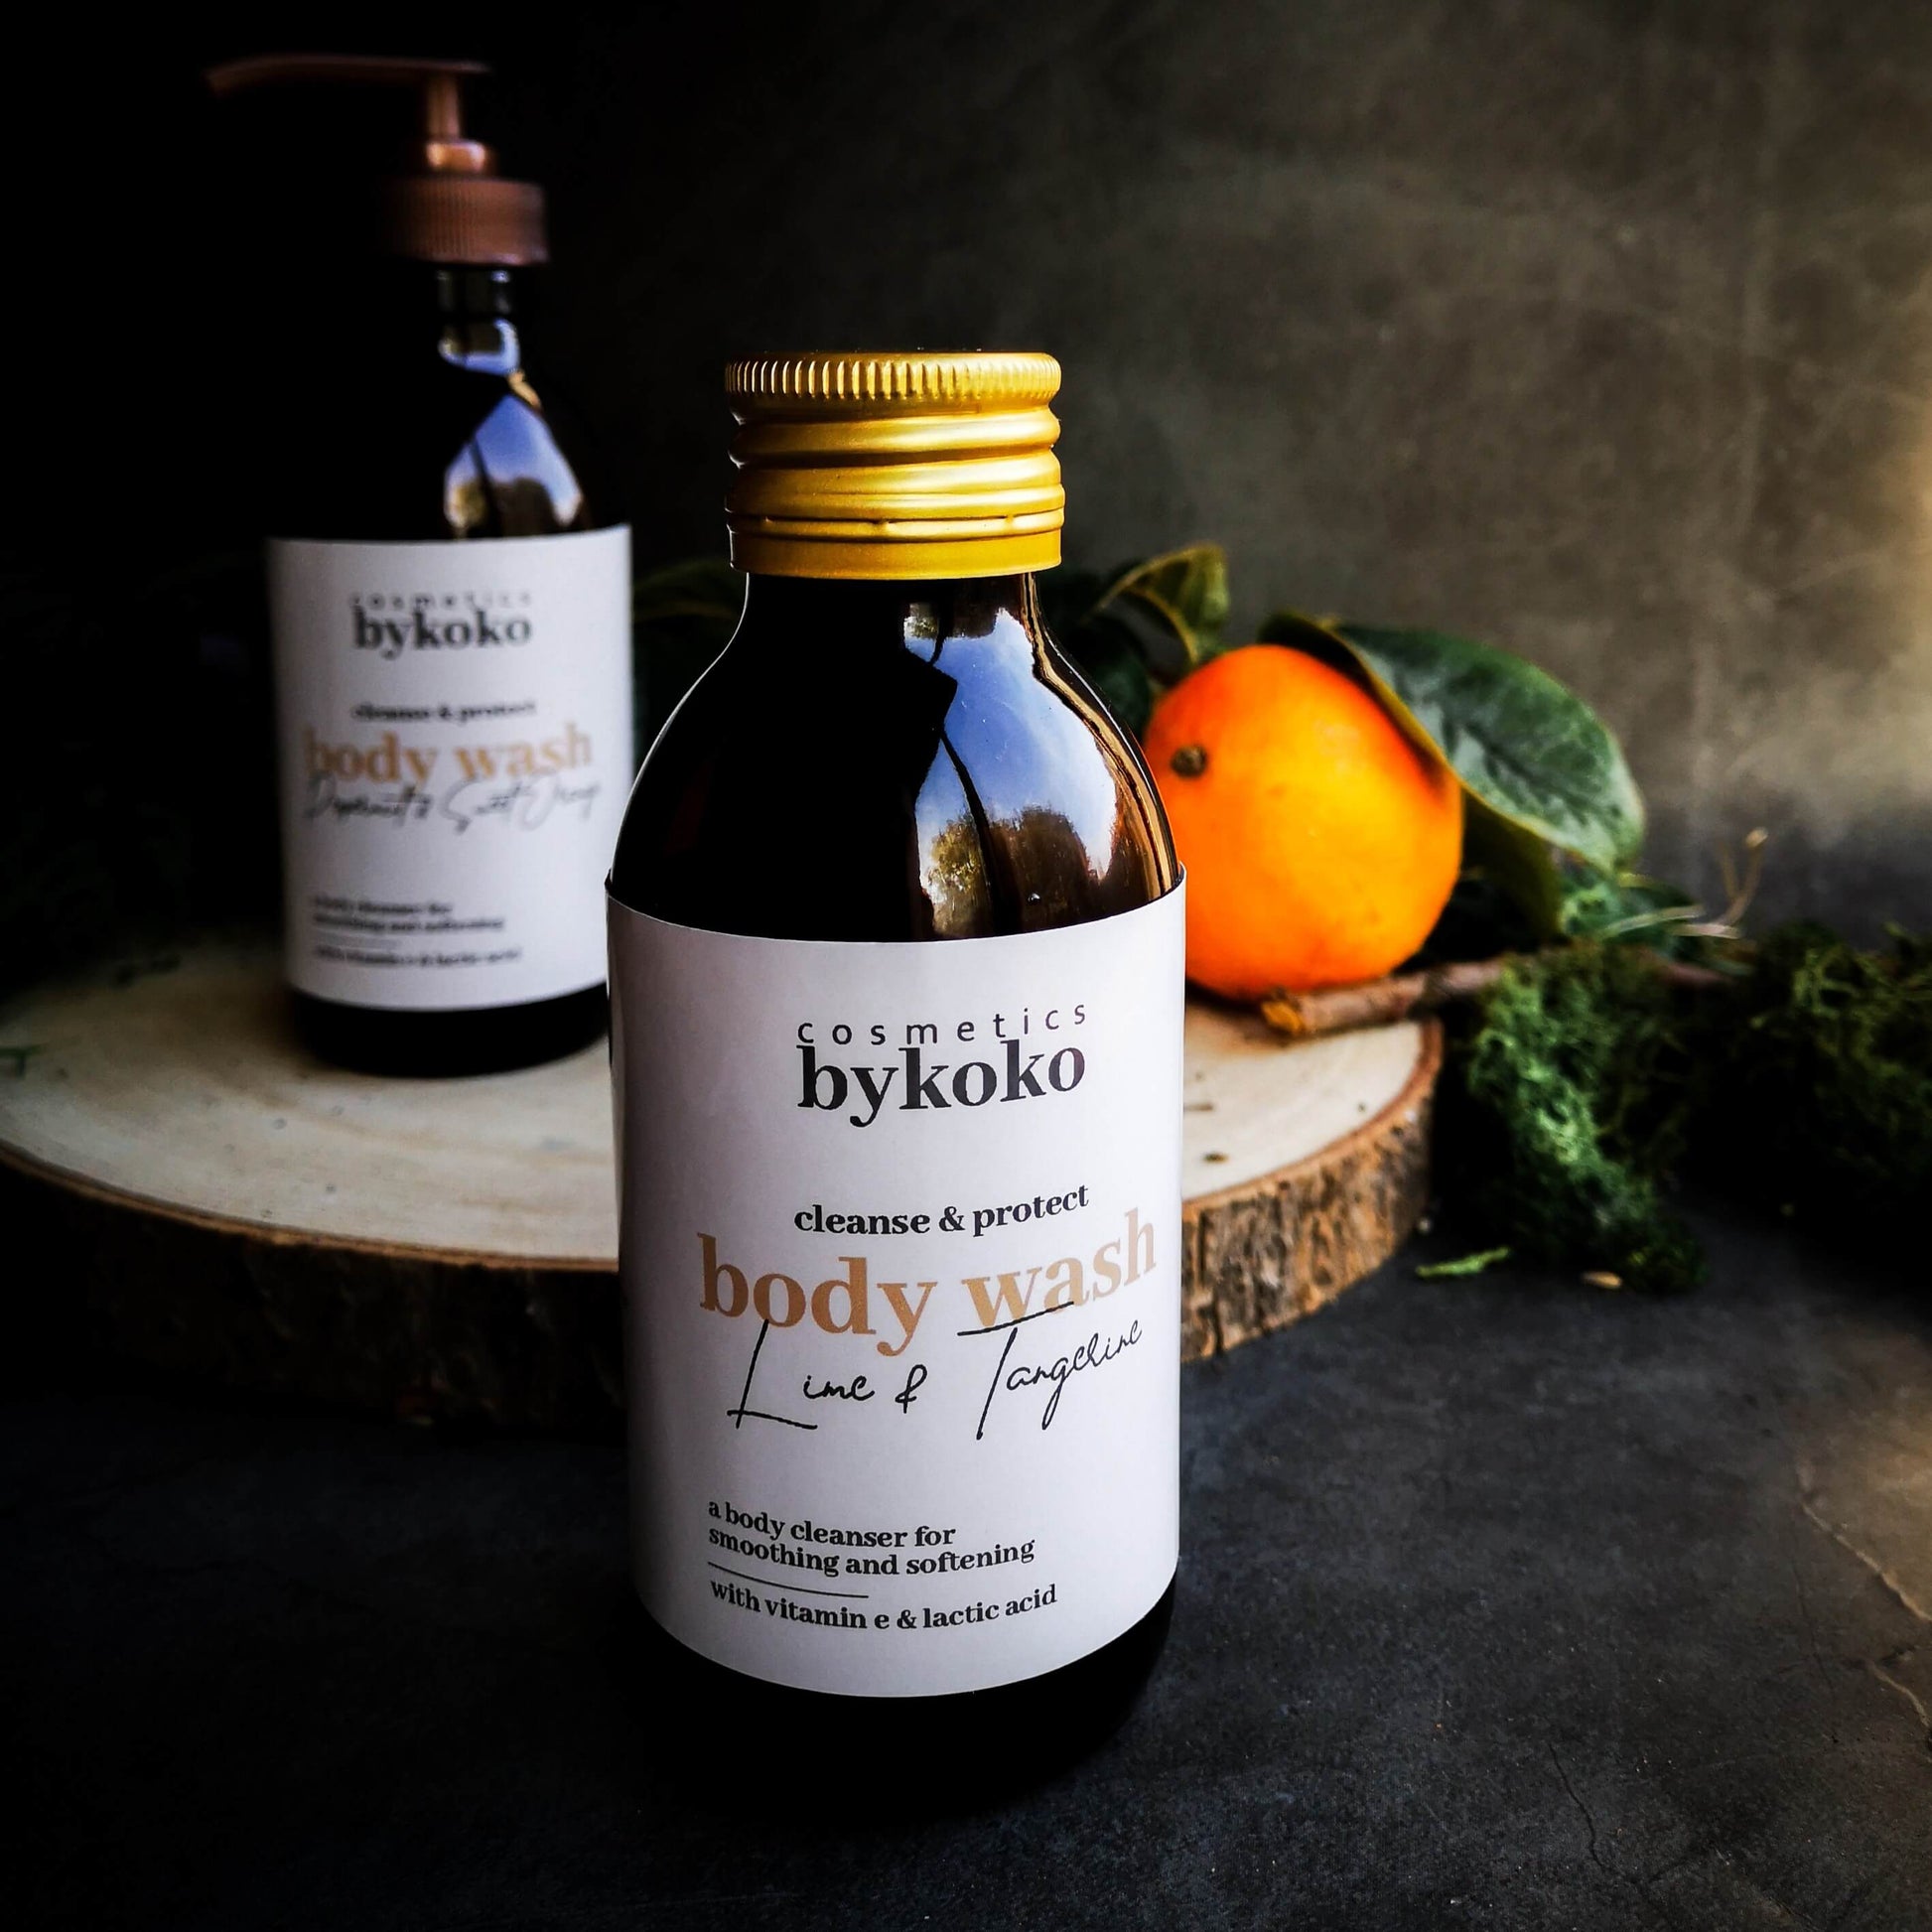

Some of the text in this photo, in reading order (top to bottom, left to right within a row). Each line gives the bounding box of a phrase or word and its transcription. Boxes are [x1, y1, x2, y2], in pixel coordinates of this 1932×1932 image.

[352, 605, 533, 659] bykoko
[303, 721, 593, 786] body wash
[797, 1002, 1087, 1044] cosmetics
[797, 1039, 1086, 1128] bykoko
[794, 1184, 1090, 1237] cleanse & protect
[697, 1207, 1158, 1357] body wash
[727, 1319, 876, 1431] Lime
[895, 1364, 928, 1414] &
[708, 1500, 957, 1548] a body cleanser for
[708, 1526, 1036, 1578] smoothing and softening
[710, 1580, 1057, 1629] with vitamin e & lactic acid
